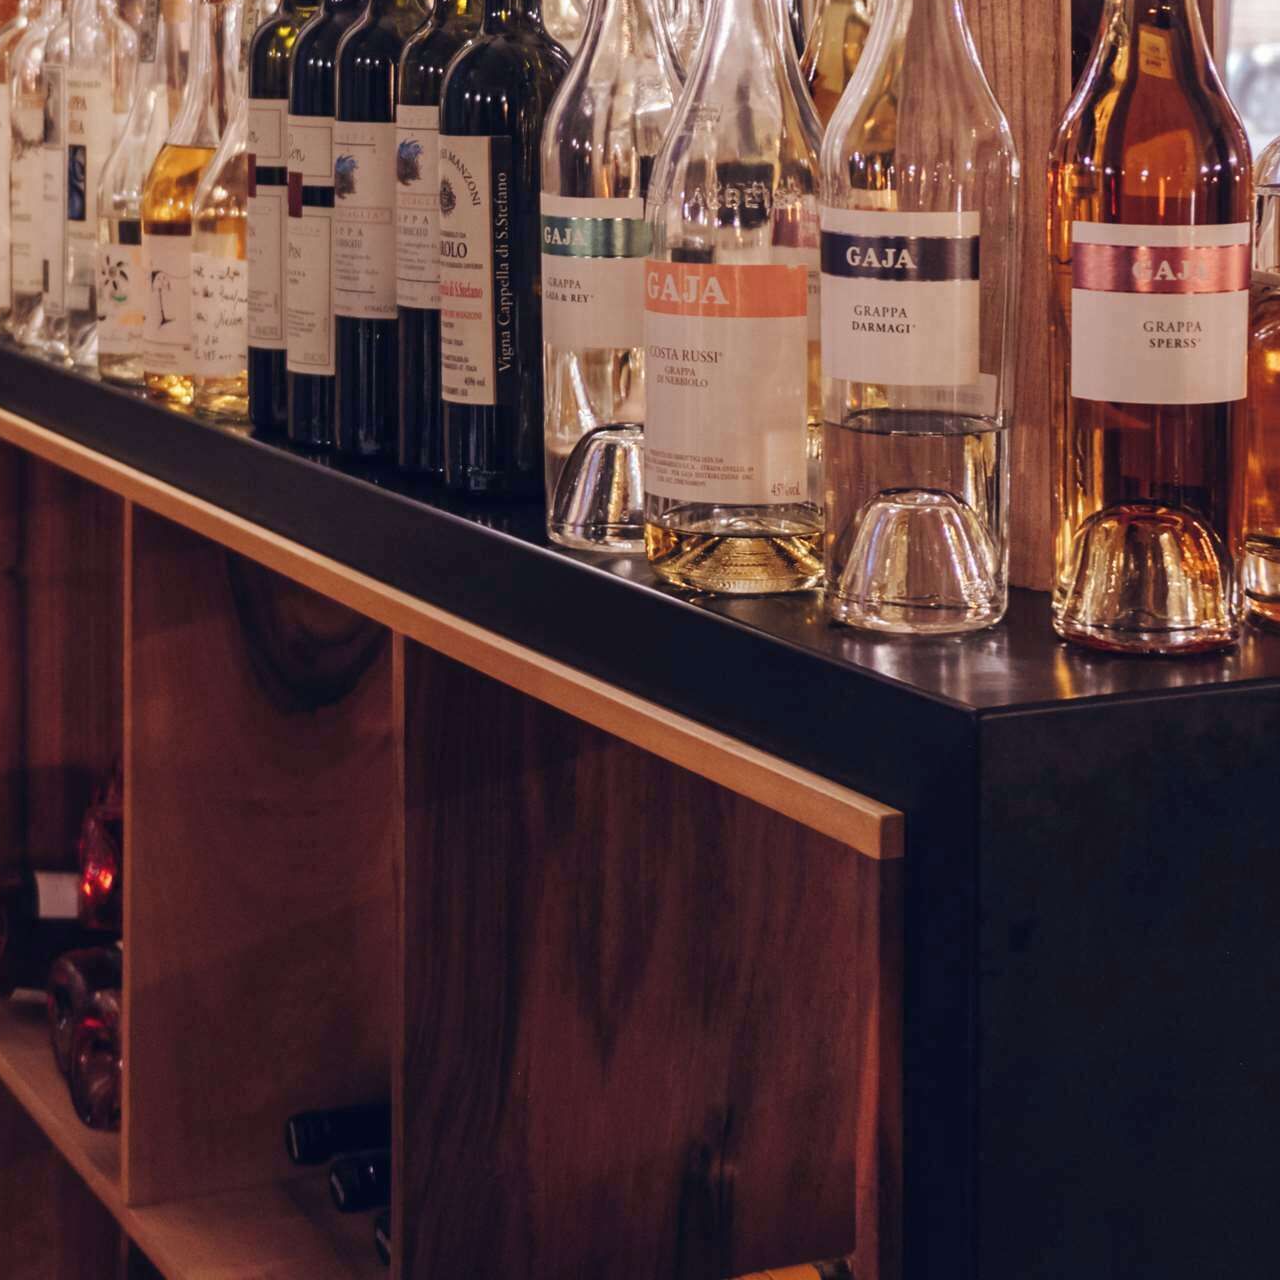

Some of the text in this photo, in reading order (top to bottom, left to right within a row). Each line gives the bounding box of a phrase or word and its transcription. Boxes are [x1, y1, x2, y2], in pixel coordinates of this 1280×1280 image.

[448, 151, 481, 207] MANZONI
[543, 226, 587, 246] GAJA
[495, 244, 509, 259] di
[845, 246, 917, 269] GAJA
[495, 262, 514, 327] Cappella
[646, 271, 730, 305] GAJA
[854, 304, 908, 319] GRAPPA
[851, 321, 911, 334] DARMAGI
[1143, 320, 1202, 333] GRAPPA
[497, 330, 514, 372] Vigna
[1149, 338, 1198, 349] SPERSS
[650, 345, 719, 363] COSTA RUSSI
[664, 366, 696, 377] GRAPPA
